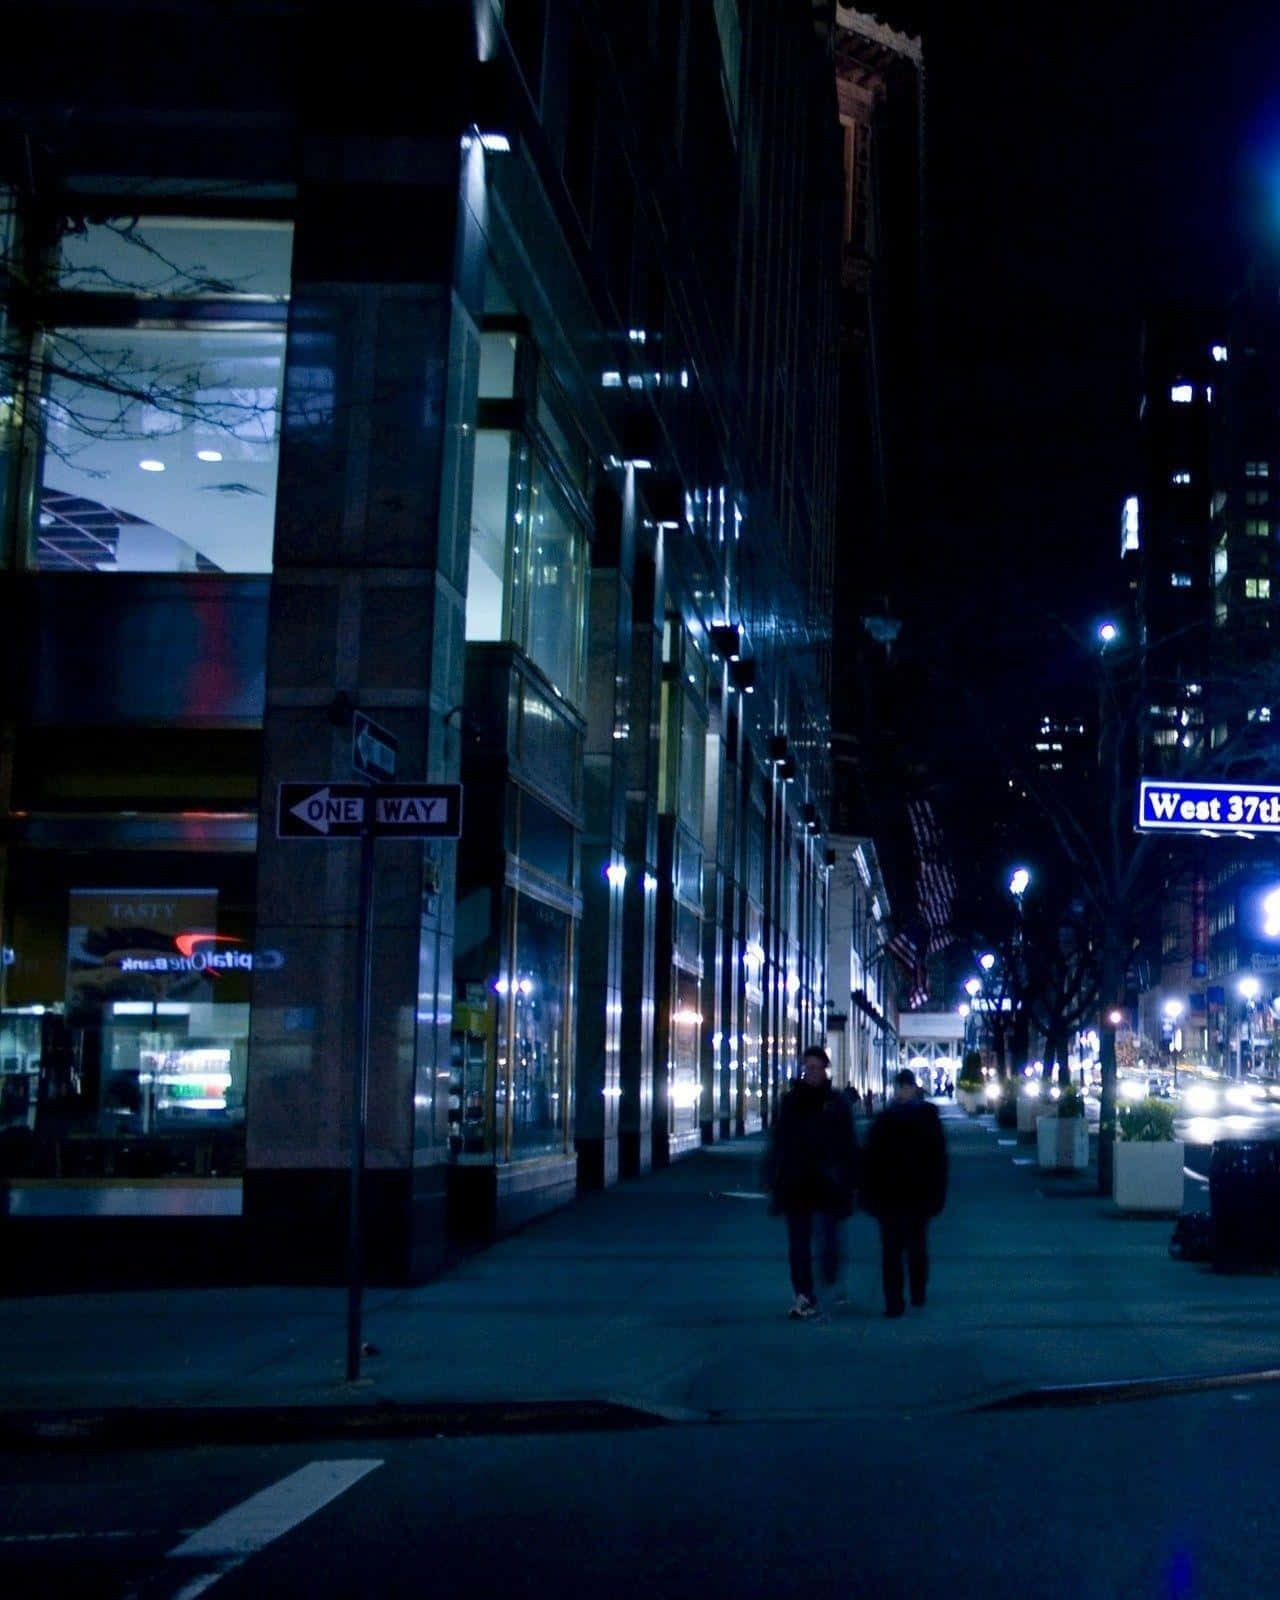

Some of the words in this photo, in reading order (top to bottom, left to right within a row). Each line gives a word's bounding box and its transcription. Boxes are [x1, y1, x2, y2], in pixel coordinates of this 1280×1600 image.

[307, 800, 358, 821] ONE
[383, 800, 437, 821] WAY
[1148, 792, 1221, 821] West
[110, 902, 177, 919] TASTY
